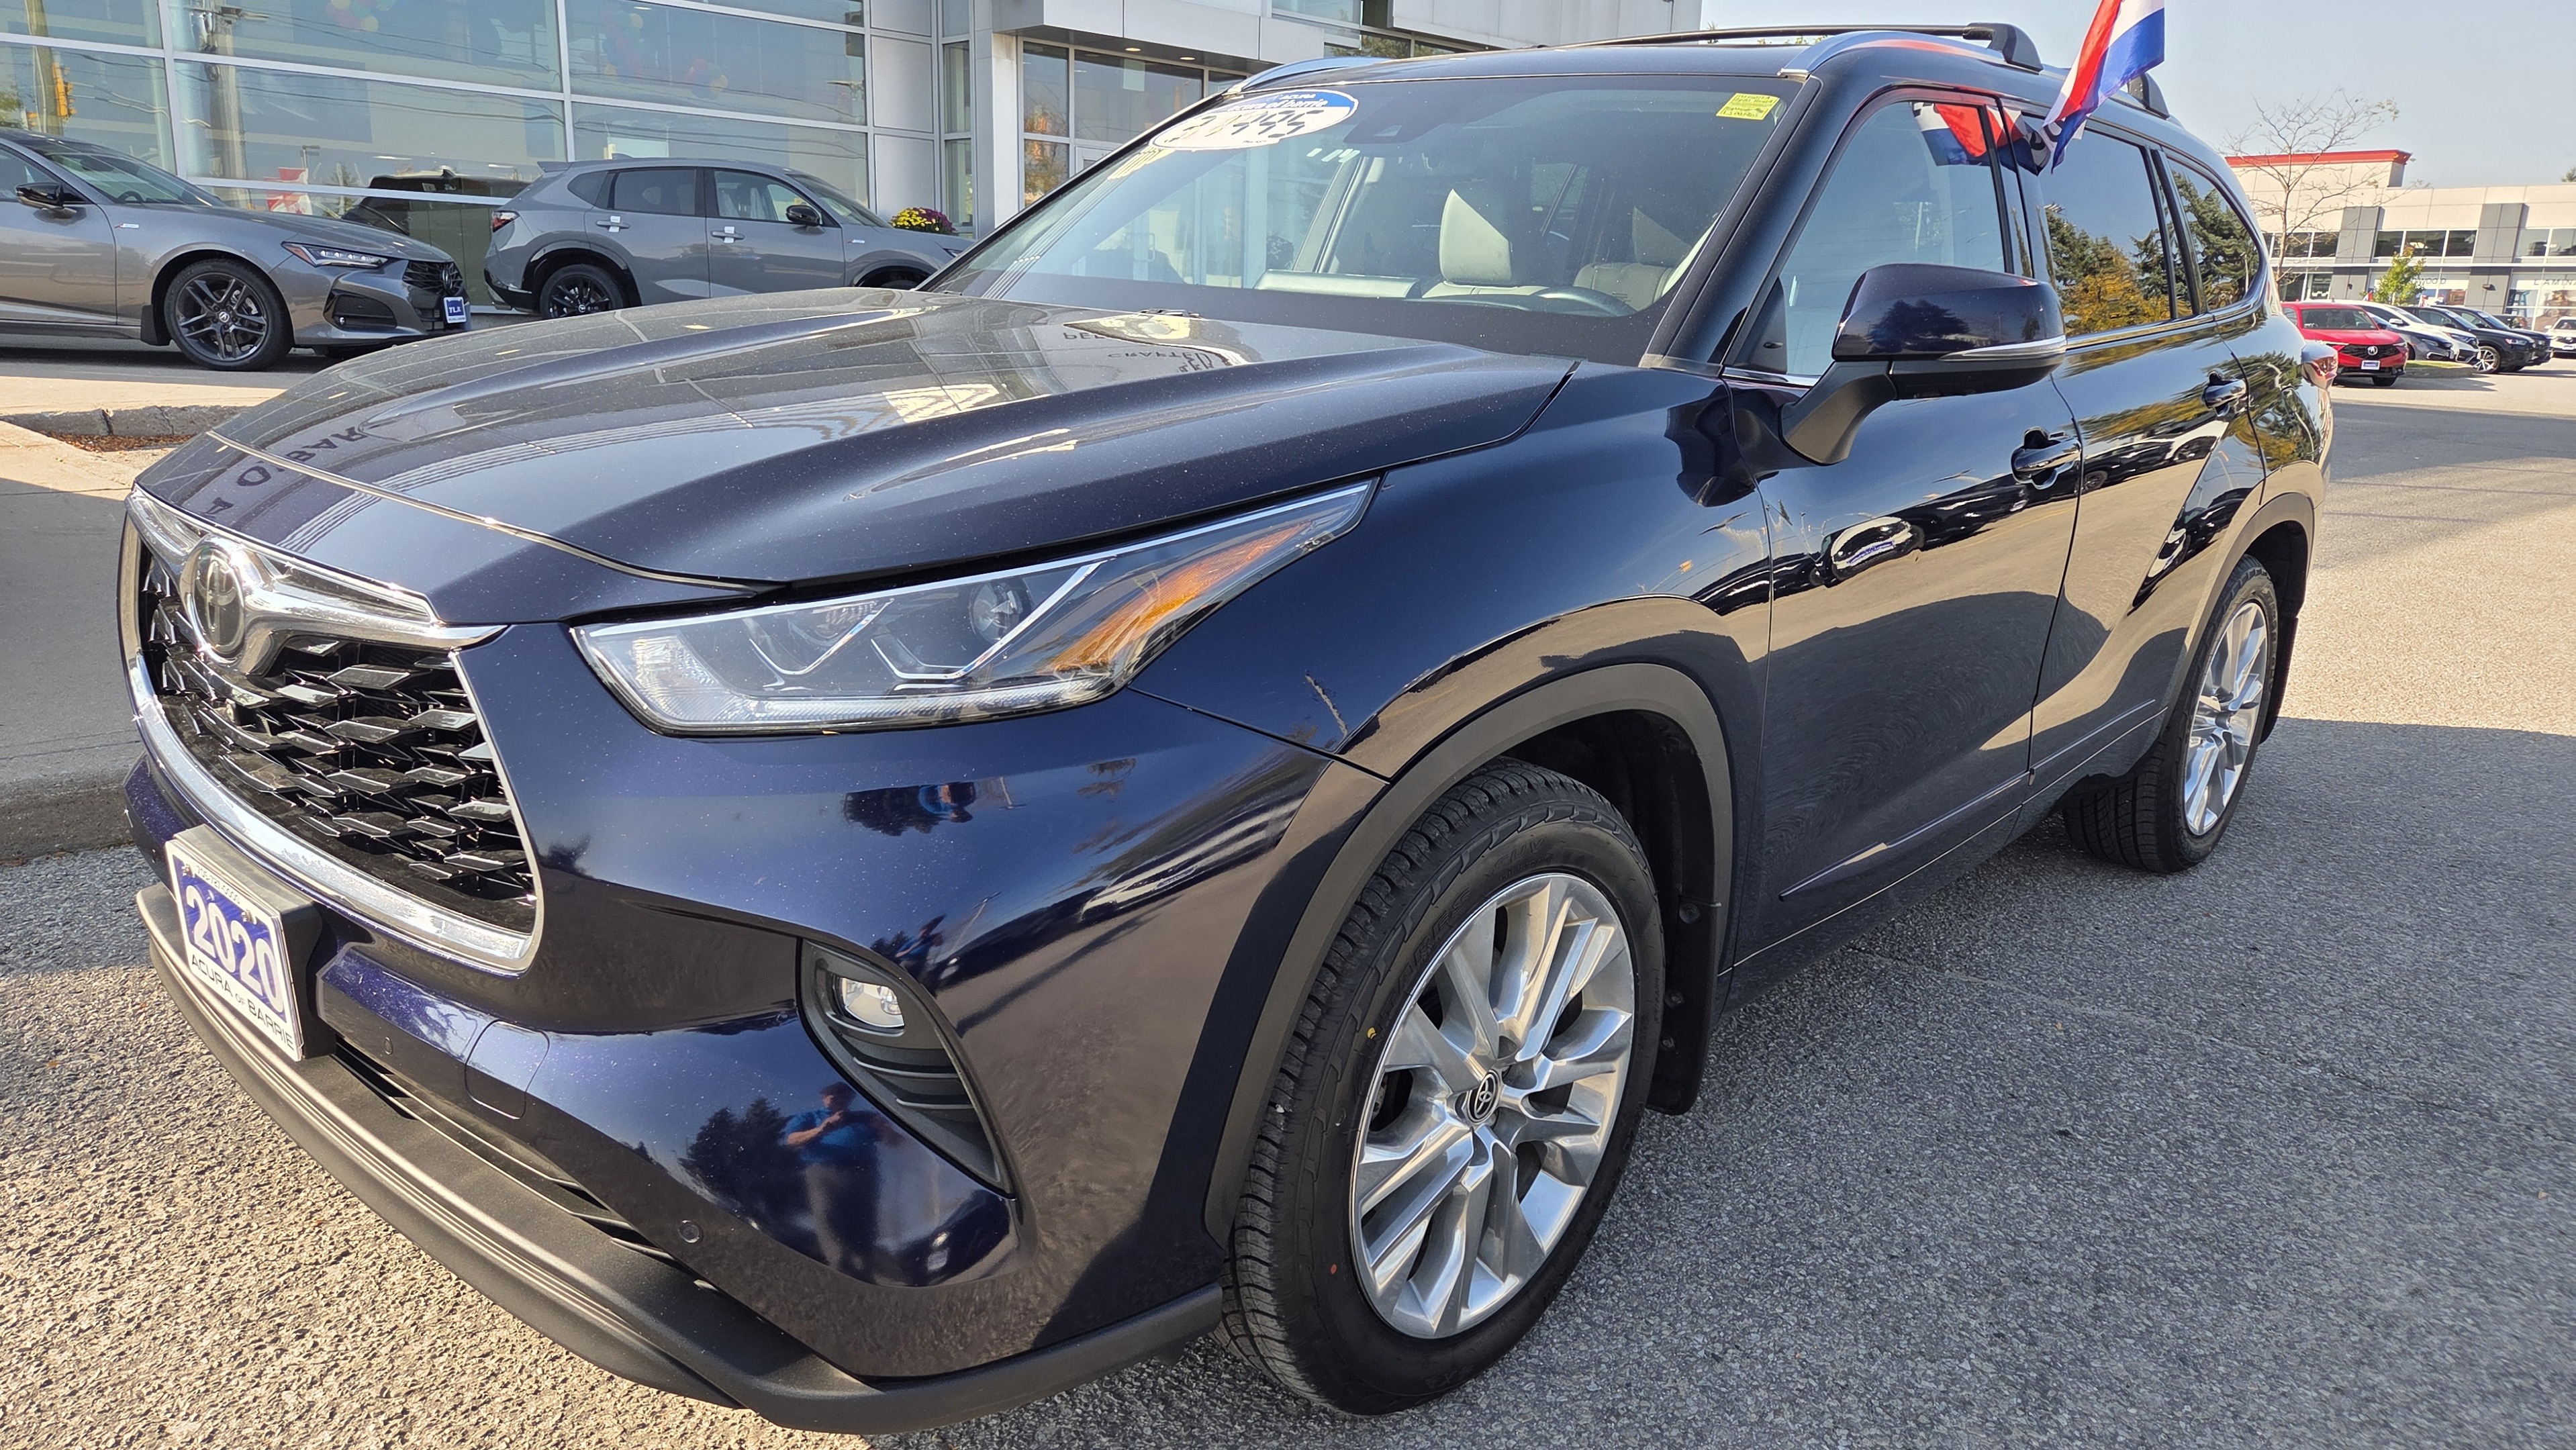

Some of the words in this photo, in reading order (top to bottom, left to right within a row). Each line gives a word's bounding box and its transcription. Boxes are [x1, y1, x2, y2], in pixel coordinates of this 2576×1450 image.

[1266, 99, 1289, 109] of
[1281, 99, 1329, 107] barrie
[185, 885, 284, 1013] 2020
[191, 954, 234, 998] ACURA
[235, 993, 246, 1006] OF
[247, 998, 295, 1051] BARRIE
